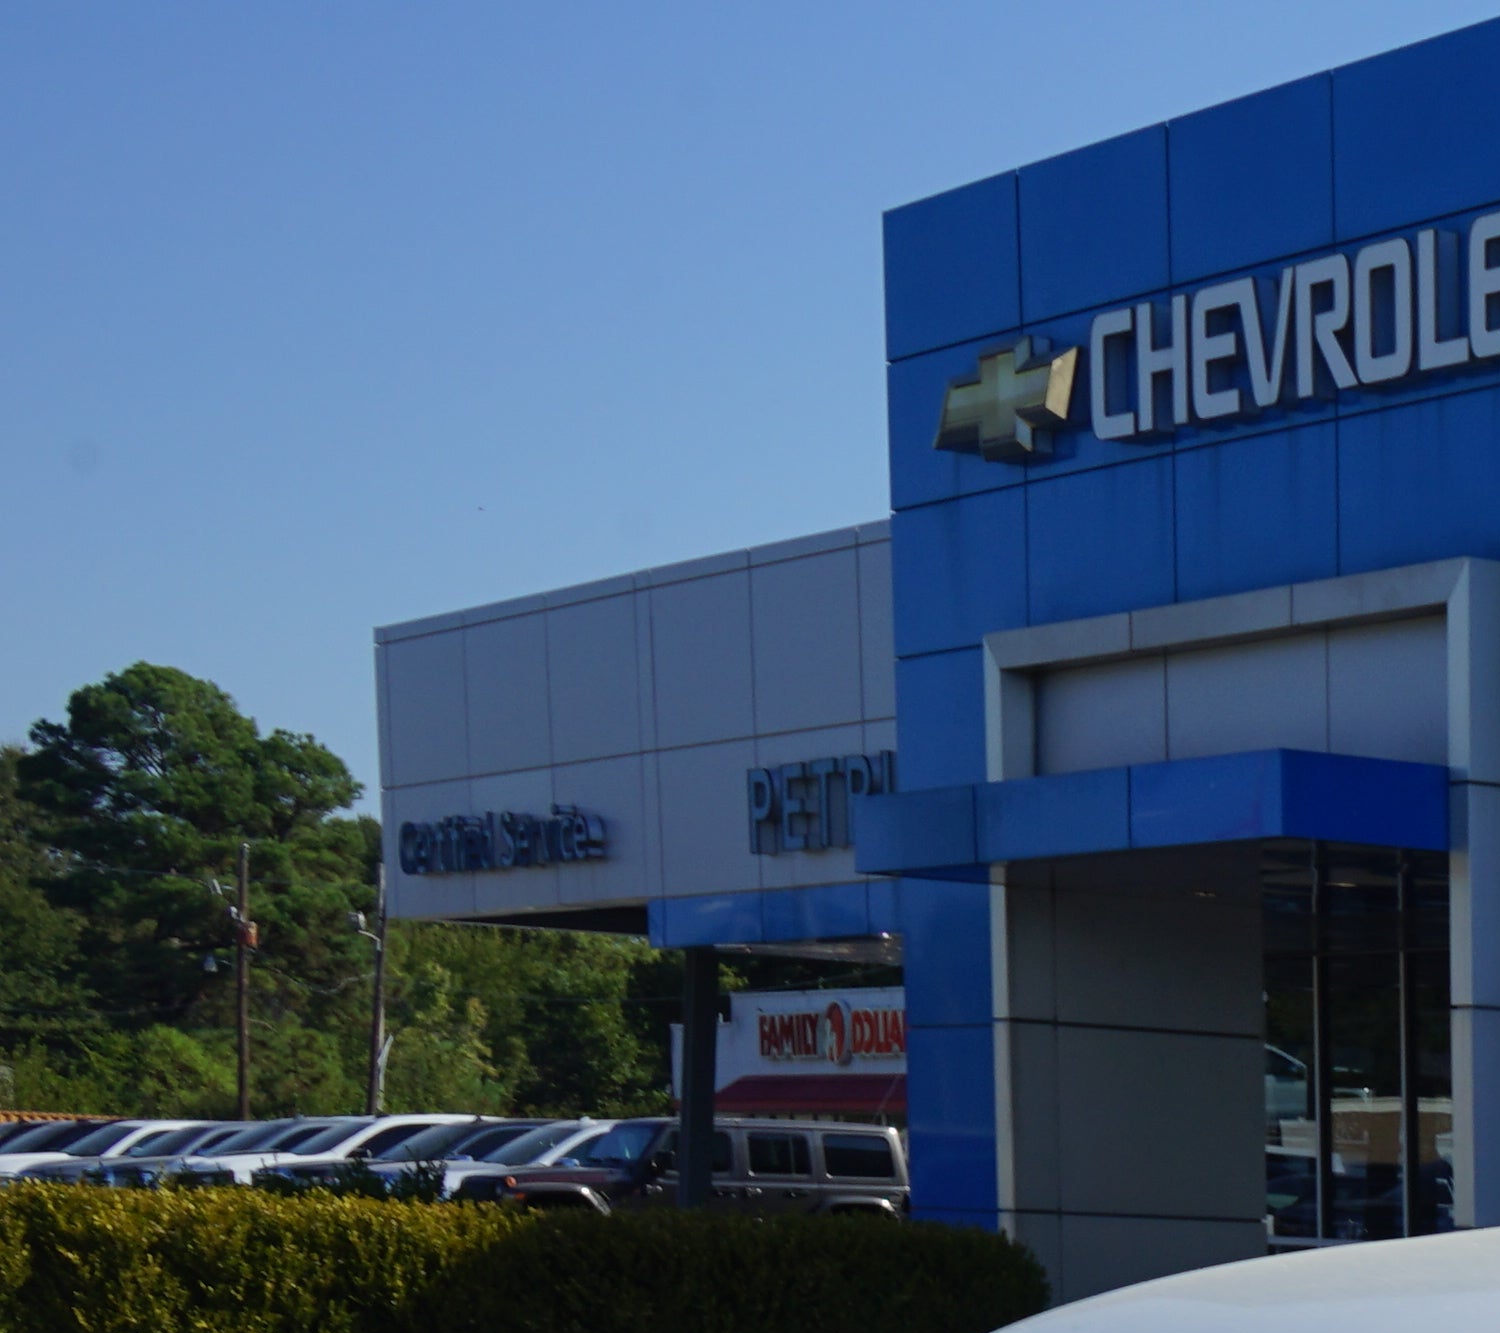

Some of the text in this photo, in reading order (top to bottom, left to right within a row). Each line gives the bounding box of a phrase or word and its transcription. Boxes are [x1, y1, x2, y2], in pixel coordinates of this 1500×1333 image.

[500, 802, 608, 868] Service
[757, 1009, 909, 1058] FAMILY DOLLA
